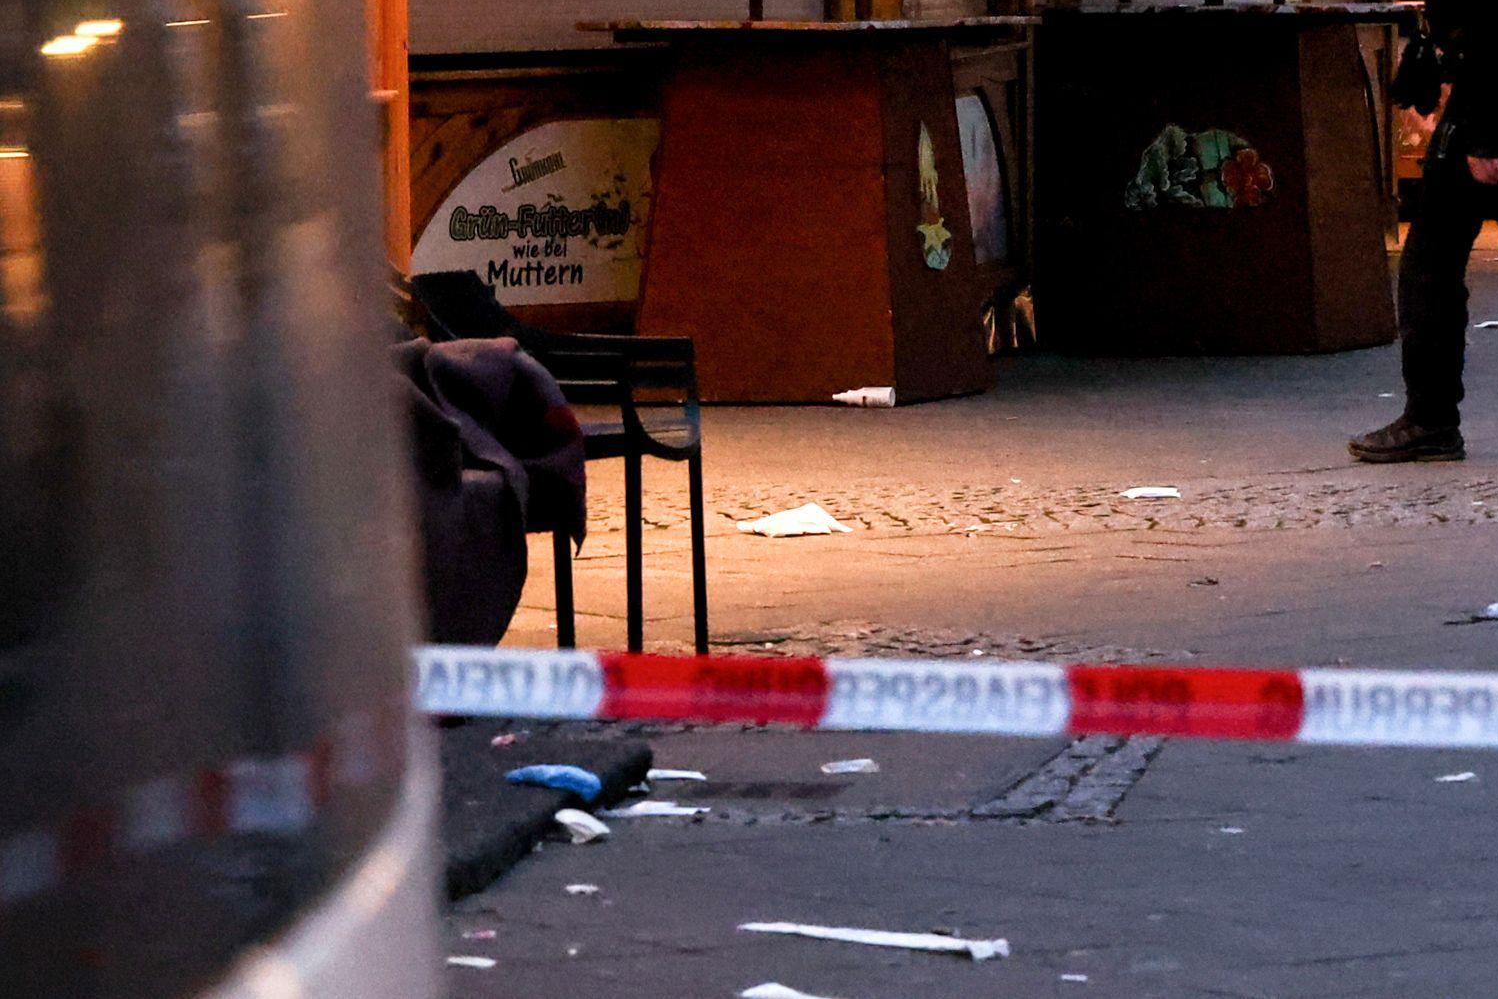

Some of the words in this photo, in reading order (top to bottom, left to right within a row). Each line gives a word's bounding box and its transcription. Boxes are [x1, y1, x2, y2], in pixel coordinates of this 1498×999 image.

[513, 240, 540, 259] wie
[543, 239, 568, 258] bei
[487, 259, 584, 288] Muttern
